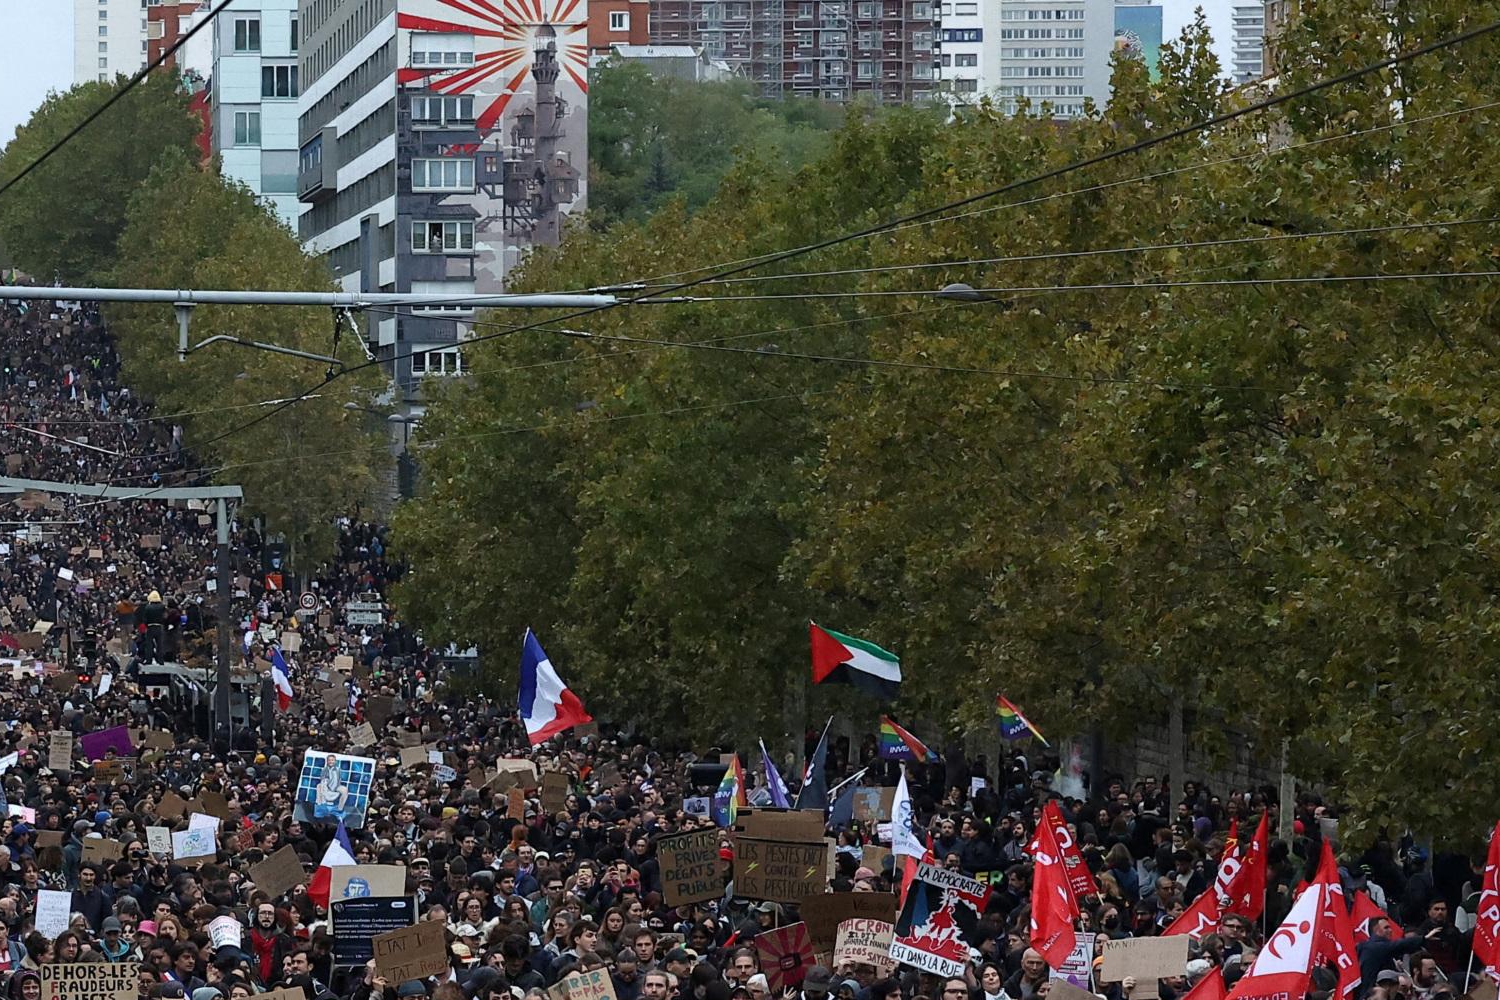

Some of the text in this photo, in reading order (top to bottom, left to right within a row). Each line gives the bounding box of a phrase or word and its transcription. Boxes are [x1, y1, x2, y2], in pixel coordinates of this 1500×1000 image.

[304, 597, 314, 606] 50
[919, 866, 931, 881] LA
[892, 943, 906, 958] EST
[907, 947, 927, 967] DANS
[928, 954, 939, 970] LA
[50, 980, 133, 994] FRAUDEURS
